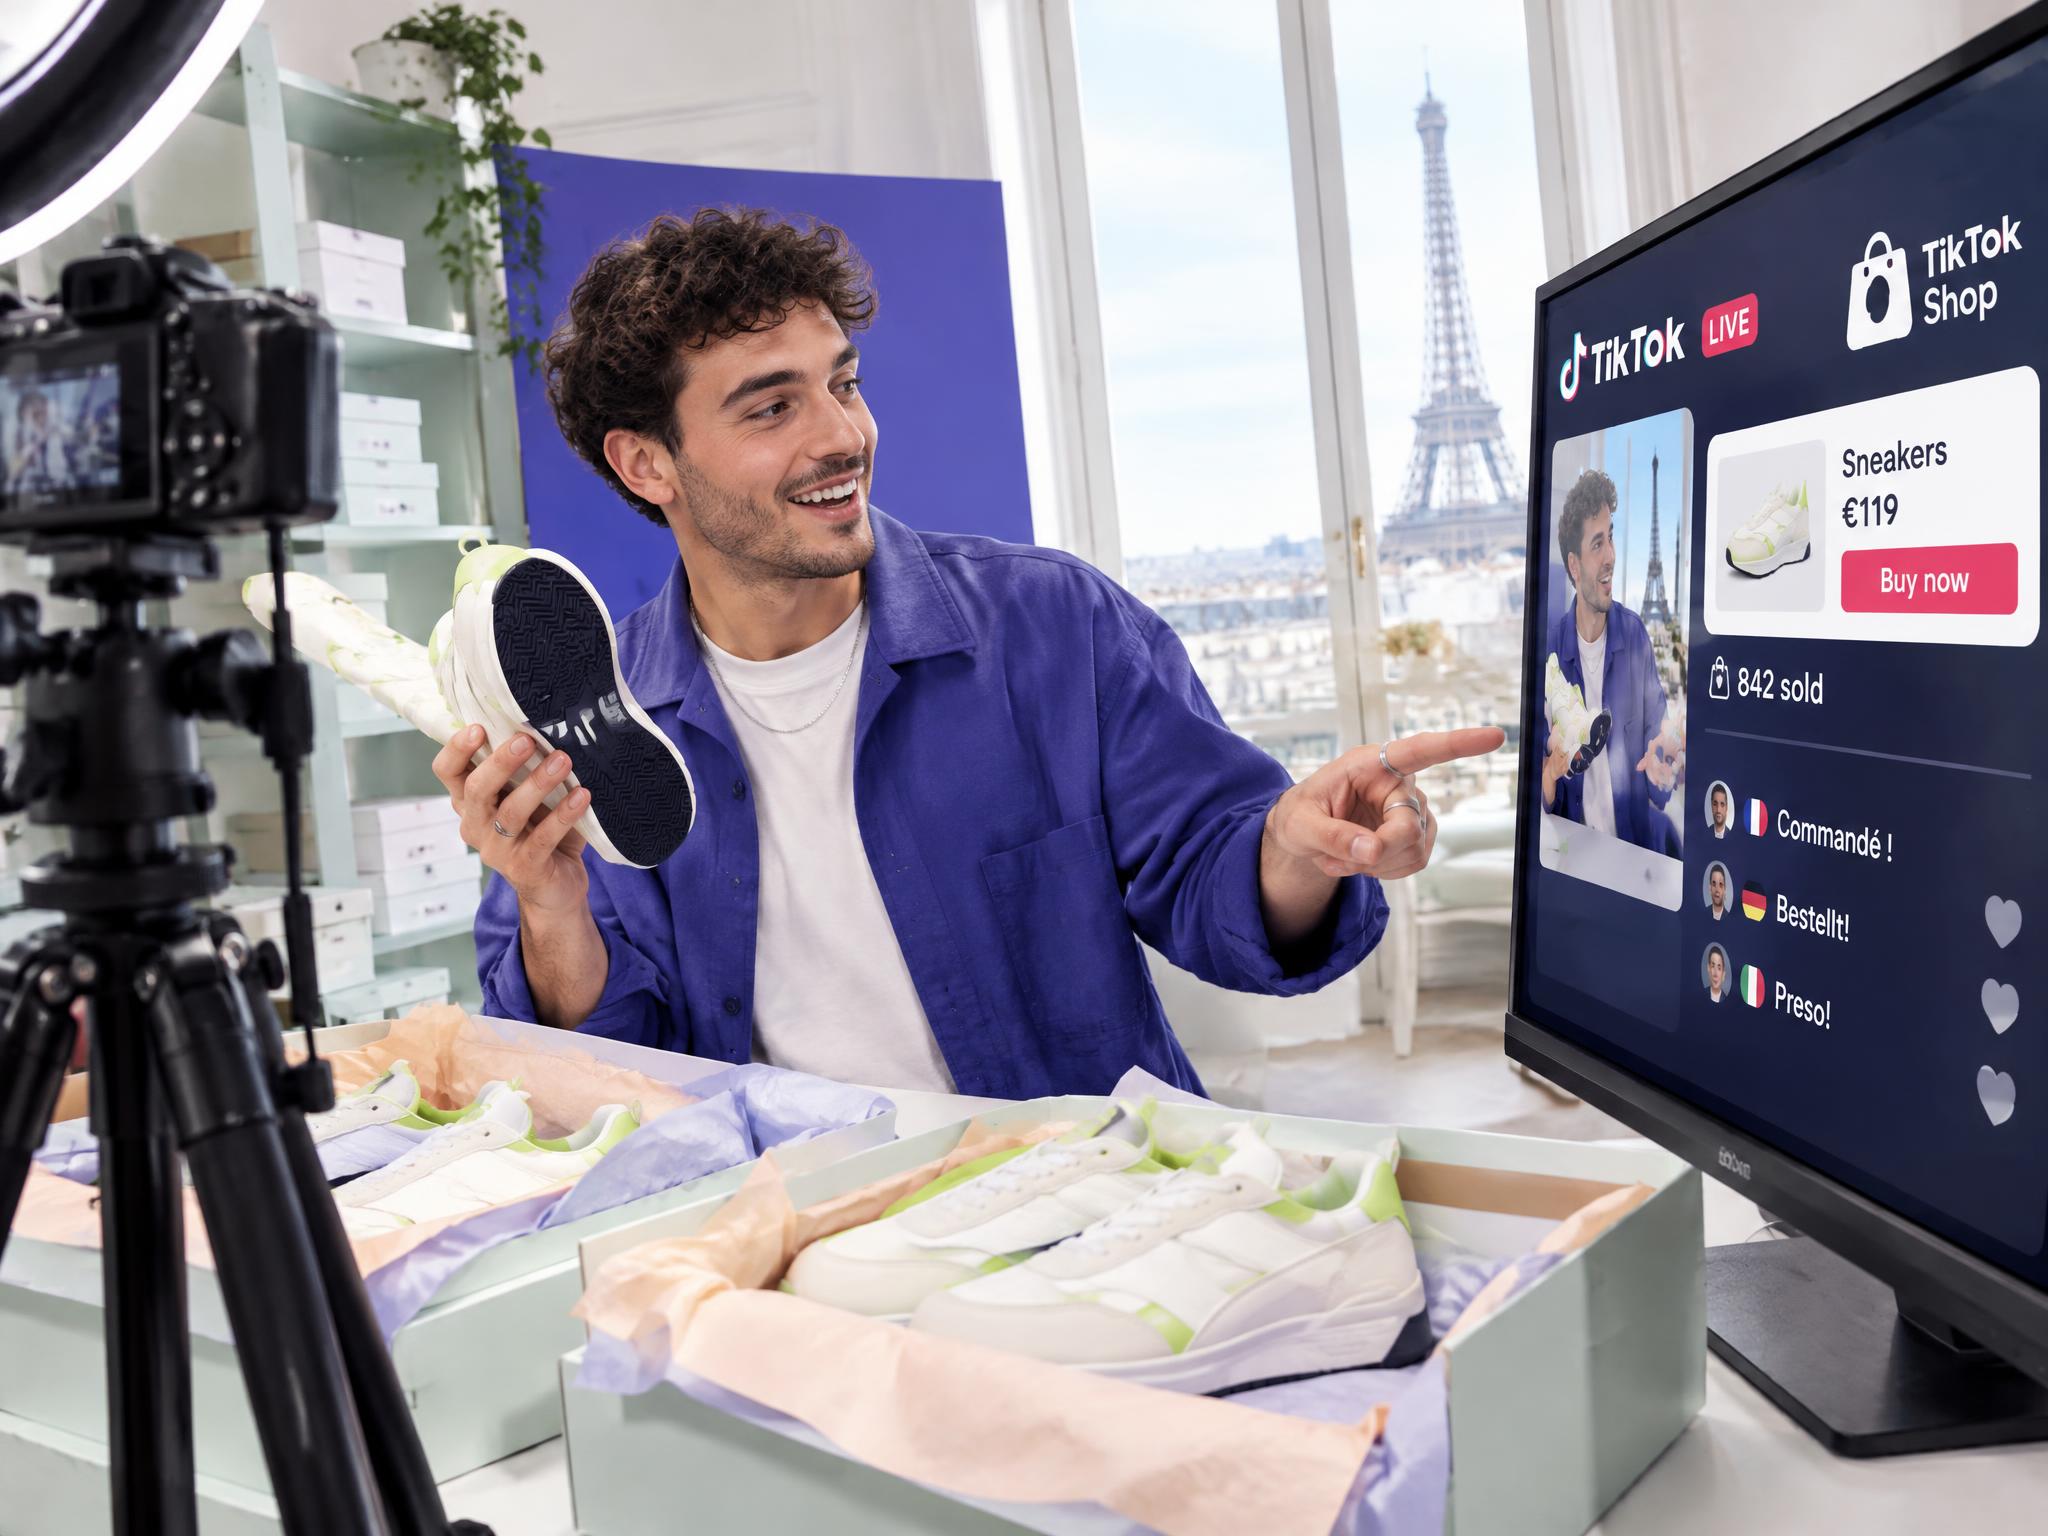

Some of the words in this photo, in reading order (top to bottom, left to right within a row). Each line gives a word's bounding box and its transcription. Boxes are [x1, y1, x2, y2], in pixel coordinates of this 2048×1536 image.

[1921, 214, 2023, 279] TikTok
[1922, 279, 1999, 325] Shop
[1590, 316, 1687, 385] TikTok
[1708, 307, 1751, 346] LIVE
[1841, 439, 1948, 479] Sneakers
[1841, 493, 1900, 529] €119
[1880, 567, 1919, 600] Buy
[1924, 571, 1970, 593] now
[1736, 667, 1775, 700] 842
[1780, 671, 1824, 705] sold
[1776, 809, 1882, 860] Commandé
[1775, 893, 1850, 943] Bestellt!
[1774, 980, 1832, 1030] Preso!
